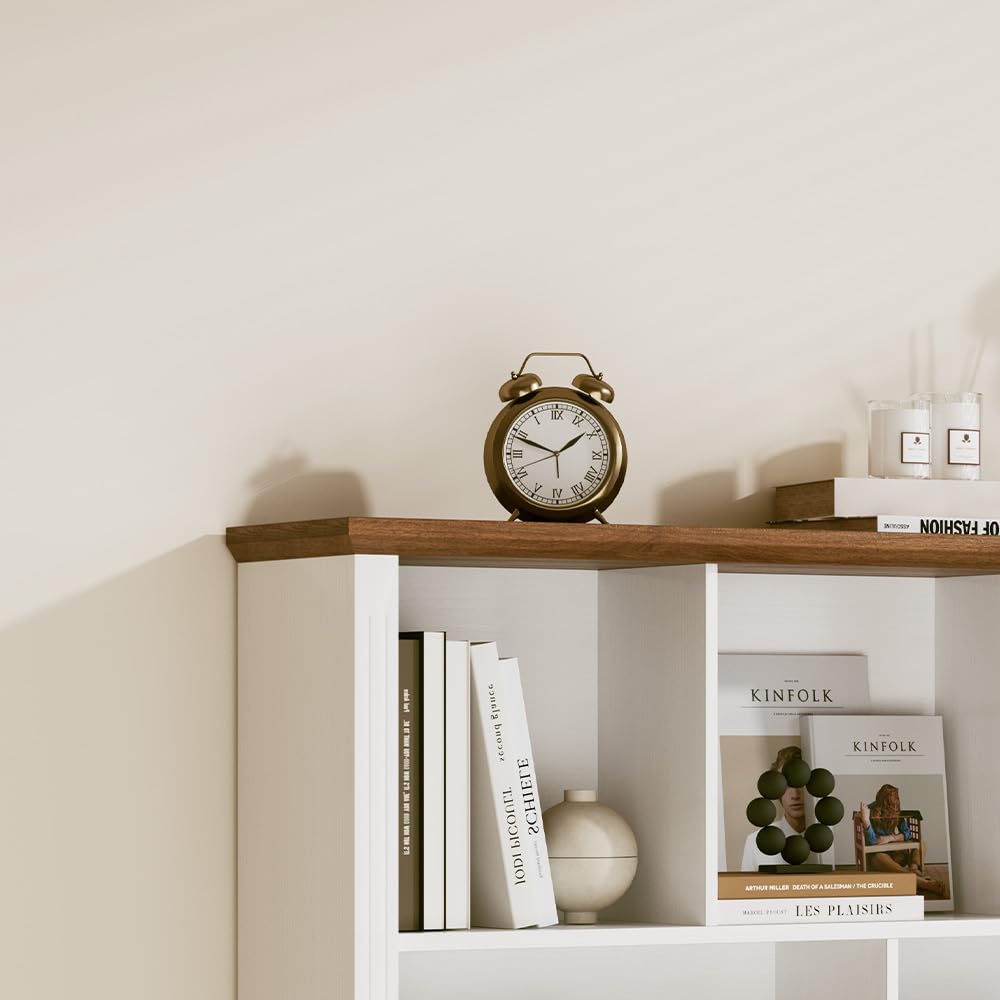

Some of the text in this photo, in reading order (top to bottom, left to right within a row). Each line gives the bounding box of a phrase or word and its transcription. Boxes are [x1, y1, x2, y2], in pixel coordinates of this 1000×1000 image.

[920, 519, 978, 535] FASHION
[983, 521, 999, 536] OF
[750, 688, 834, 703] KINFOLK
[853, 740, 917, 752] KINFOLK
[796, 904, 894, 918] LES PLAISIRS
